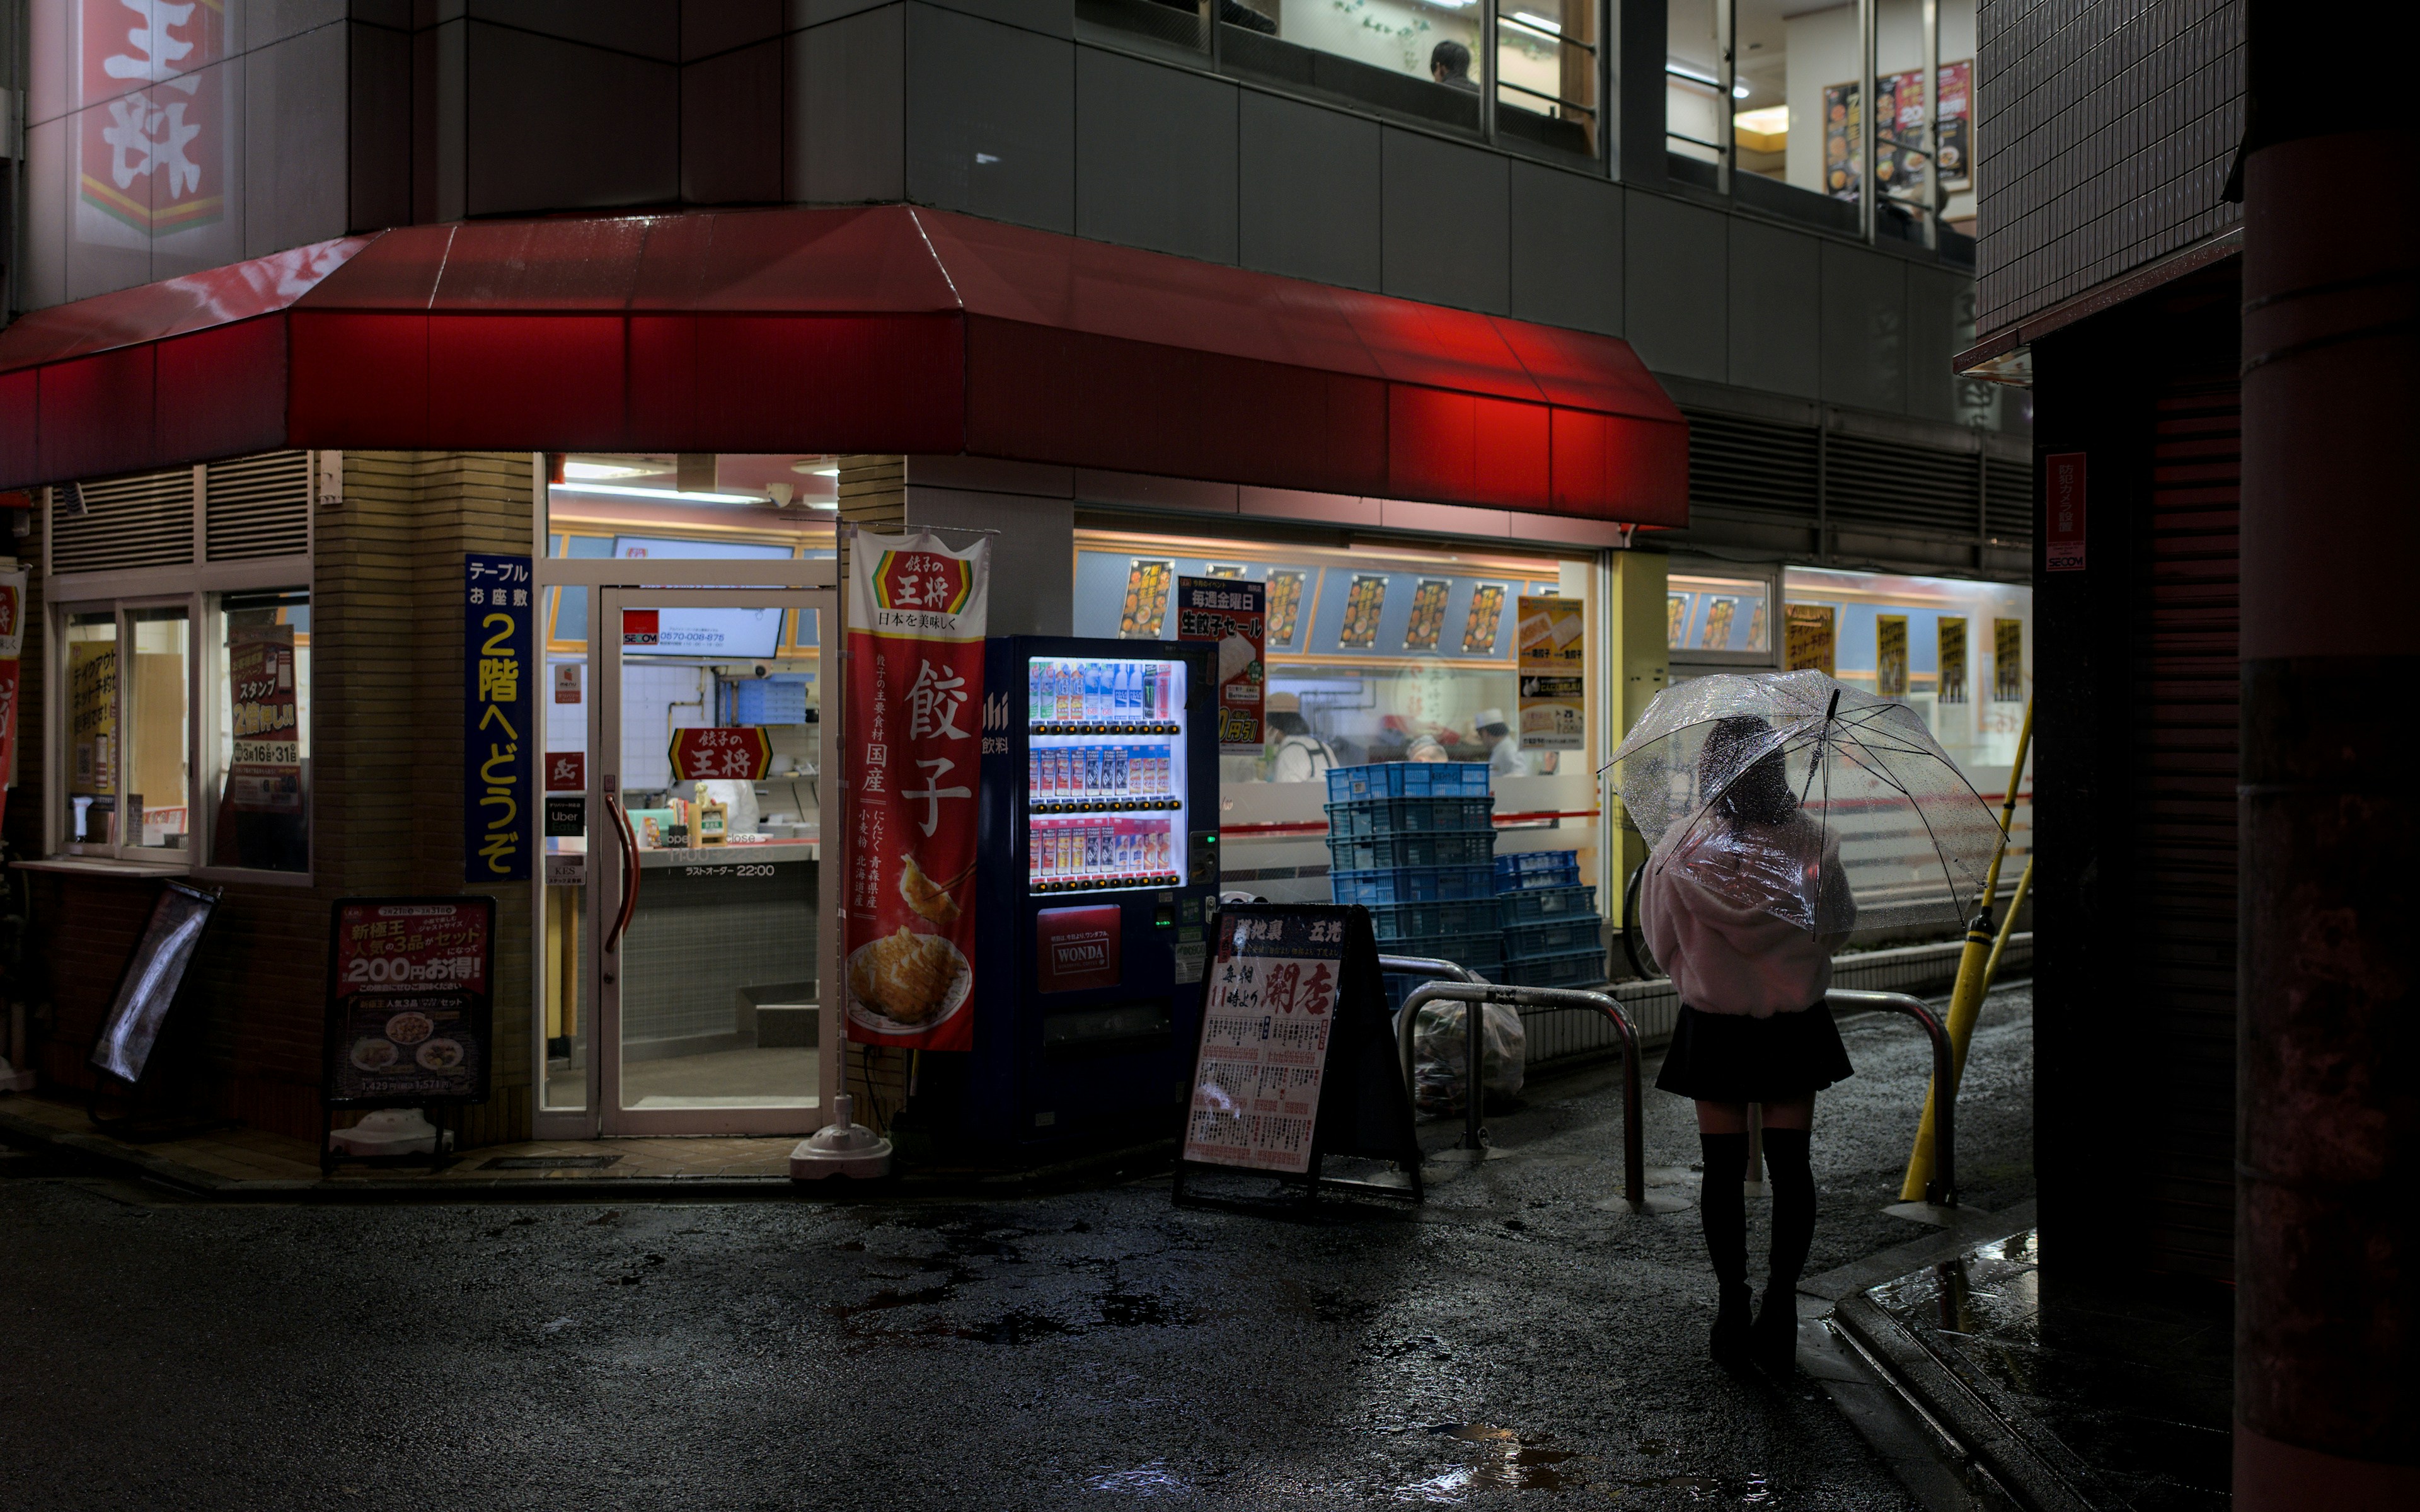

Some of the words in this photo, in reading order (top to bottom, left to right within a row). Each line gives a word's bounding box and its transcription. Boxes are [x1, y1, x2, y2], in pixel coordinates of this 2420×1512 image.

[2058, 464, 2074, 532] 防犯カメラ設置
[470, 561, 529, 583] テーブル
[906, 555, 944, 573] 餃子の
[2049, 557, 2083, 566] SECOM
[470, 587, 529, 607] お座敷
[894, 575, 948, 609] 王将
[1192, 589, 1254, 611] 毎週金曜日
[879, 612, 957, 631] 日本を美味しく
[1181, 609, 1262, 639] 生餃子セール
[625, 634, 657, 643] SECOM
[240, 676, 276, 700] スタンプ
[873, 653, 887, 742] 餃子の主要食材
[982, 691, 1008, 731] hi
[478, 612, 520, 874] 2階へどうぞ
[698, 730, 743, 747] 餃子の
[901, 658, 972, 837] 餃子
[982, 737, 1009, 755] 飲料
[689, 748, 752, 777] 王将
[862, 743, 887, 794] 国産
[552, 811, 578, 822] Uber
[553, 822, 578, 832] Eats
[725, 832, 756, 844] close
[857, 809, 870, 847] 小麦粉
[872, 811, 885, 852] にんにく
[685, 866, 735, 876] ラストオーダー
[736, 864, 775, 876] 22:00
[853, 854, 867, 907] 北海道産
[867, 855, 882, 909] 青森県産
[352, 919, 406, 941] 新極王
[418, 921, 464, 933] ジャストサイズ
[447, 944, 479, 956] になって
[1058, 944, 1104, 963] WONDA
[347, 957, 482, 983] 200円お得!
[440, 998, 463, 1008] セット
